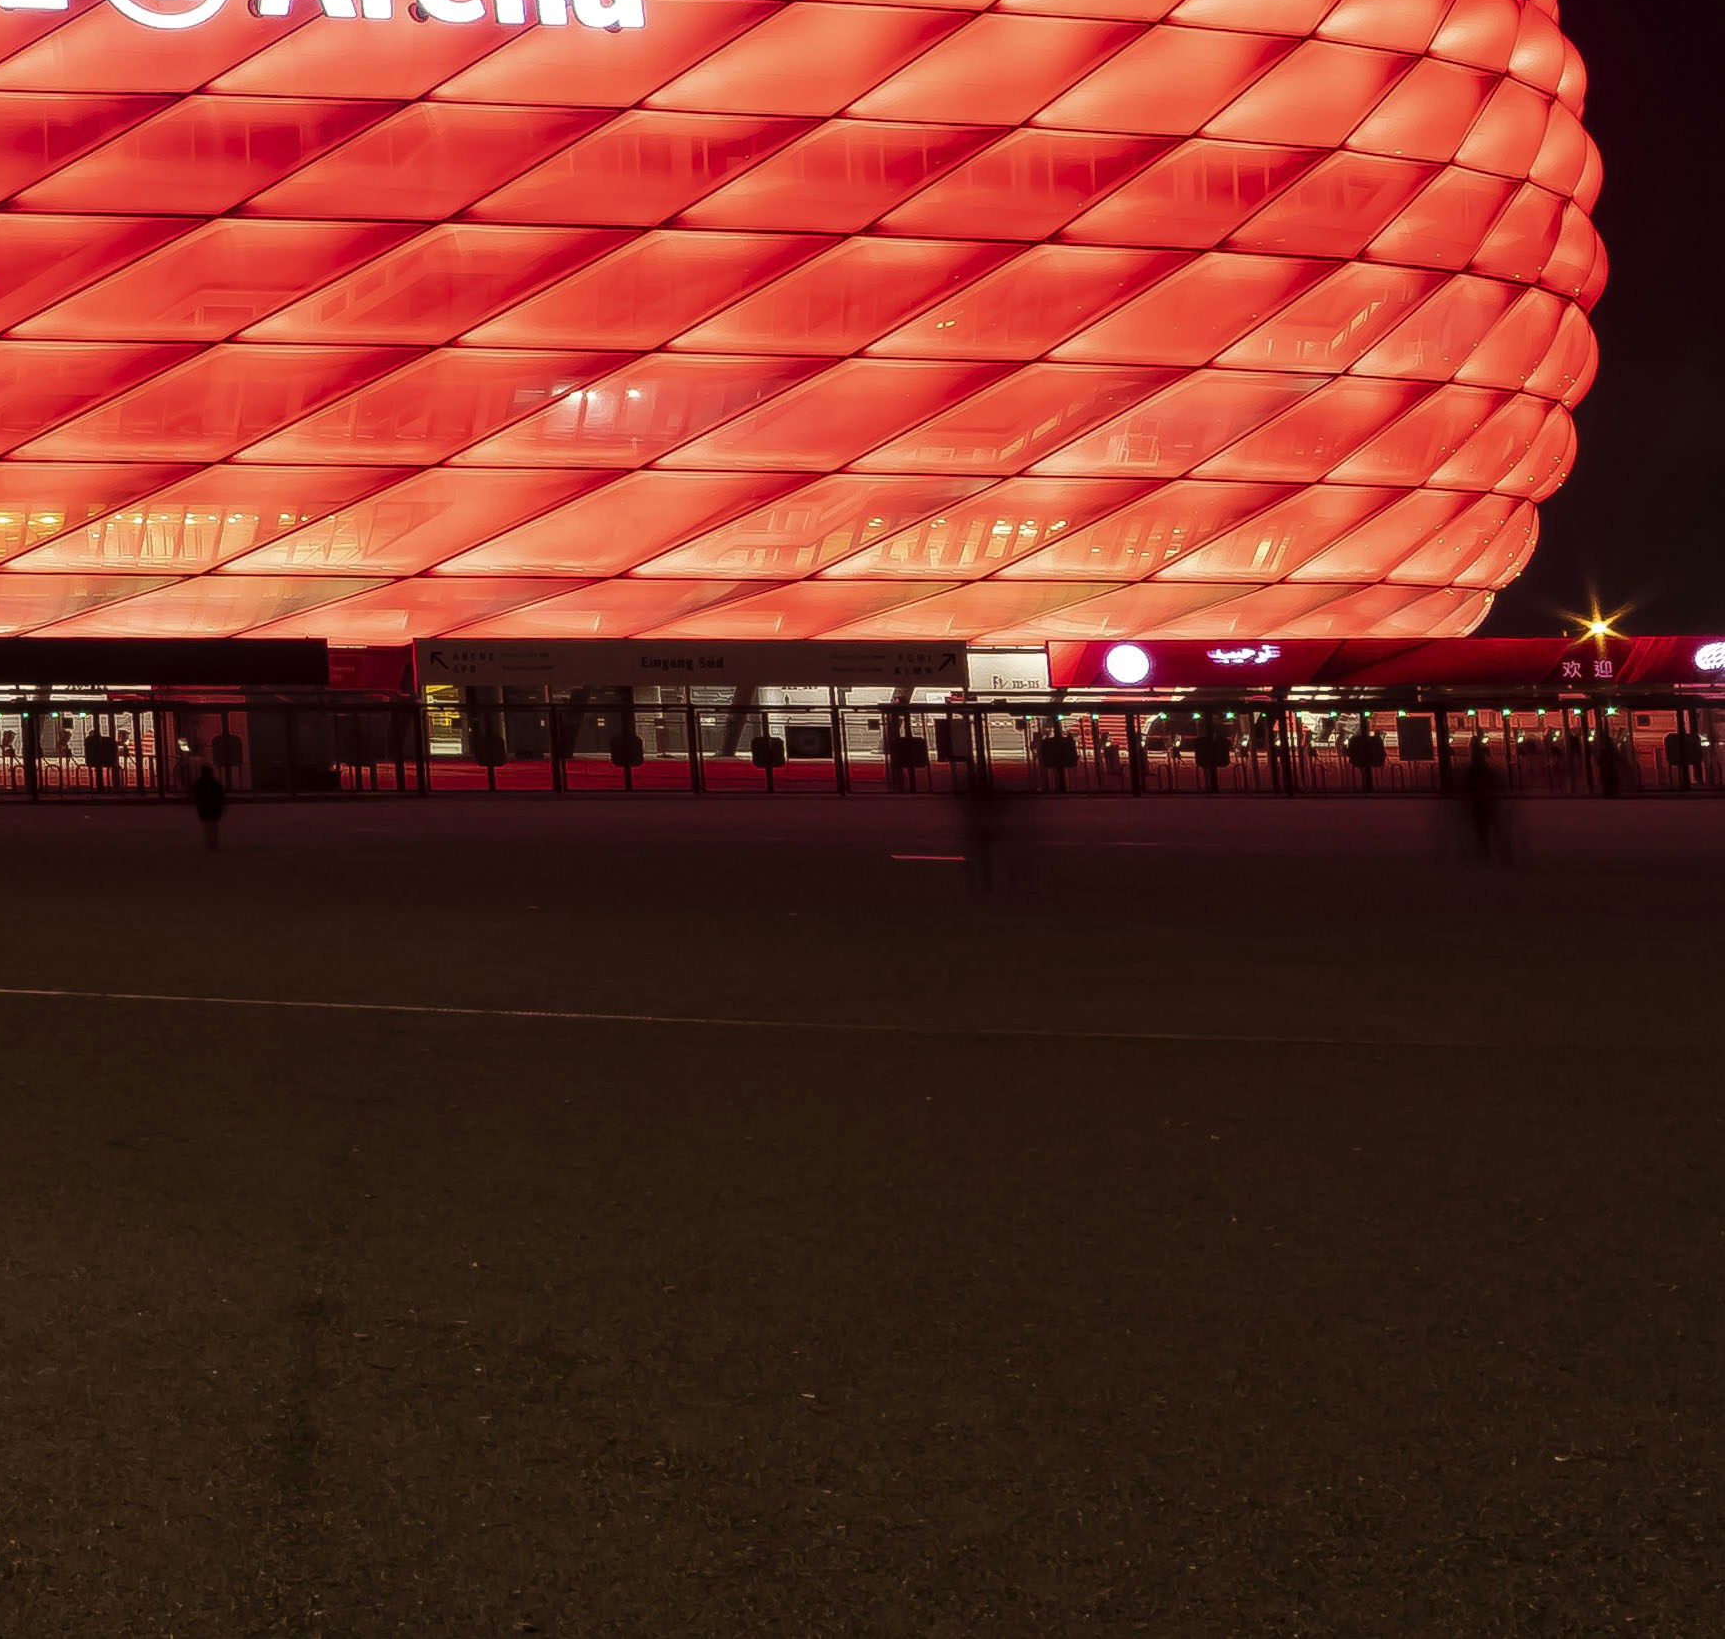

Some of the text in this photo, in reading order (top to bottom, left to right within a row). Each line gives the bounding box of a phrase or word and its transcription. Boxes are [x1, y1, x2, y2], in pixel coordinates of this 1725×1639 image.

[641, 655, 724, 671] Eingang Süd
[1562, 660, 1614, 678] 欢迎
